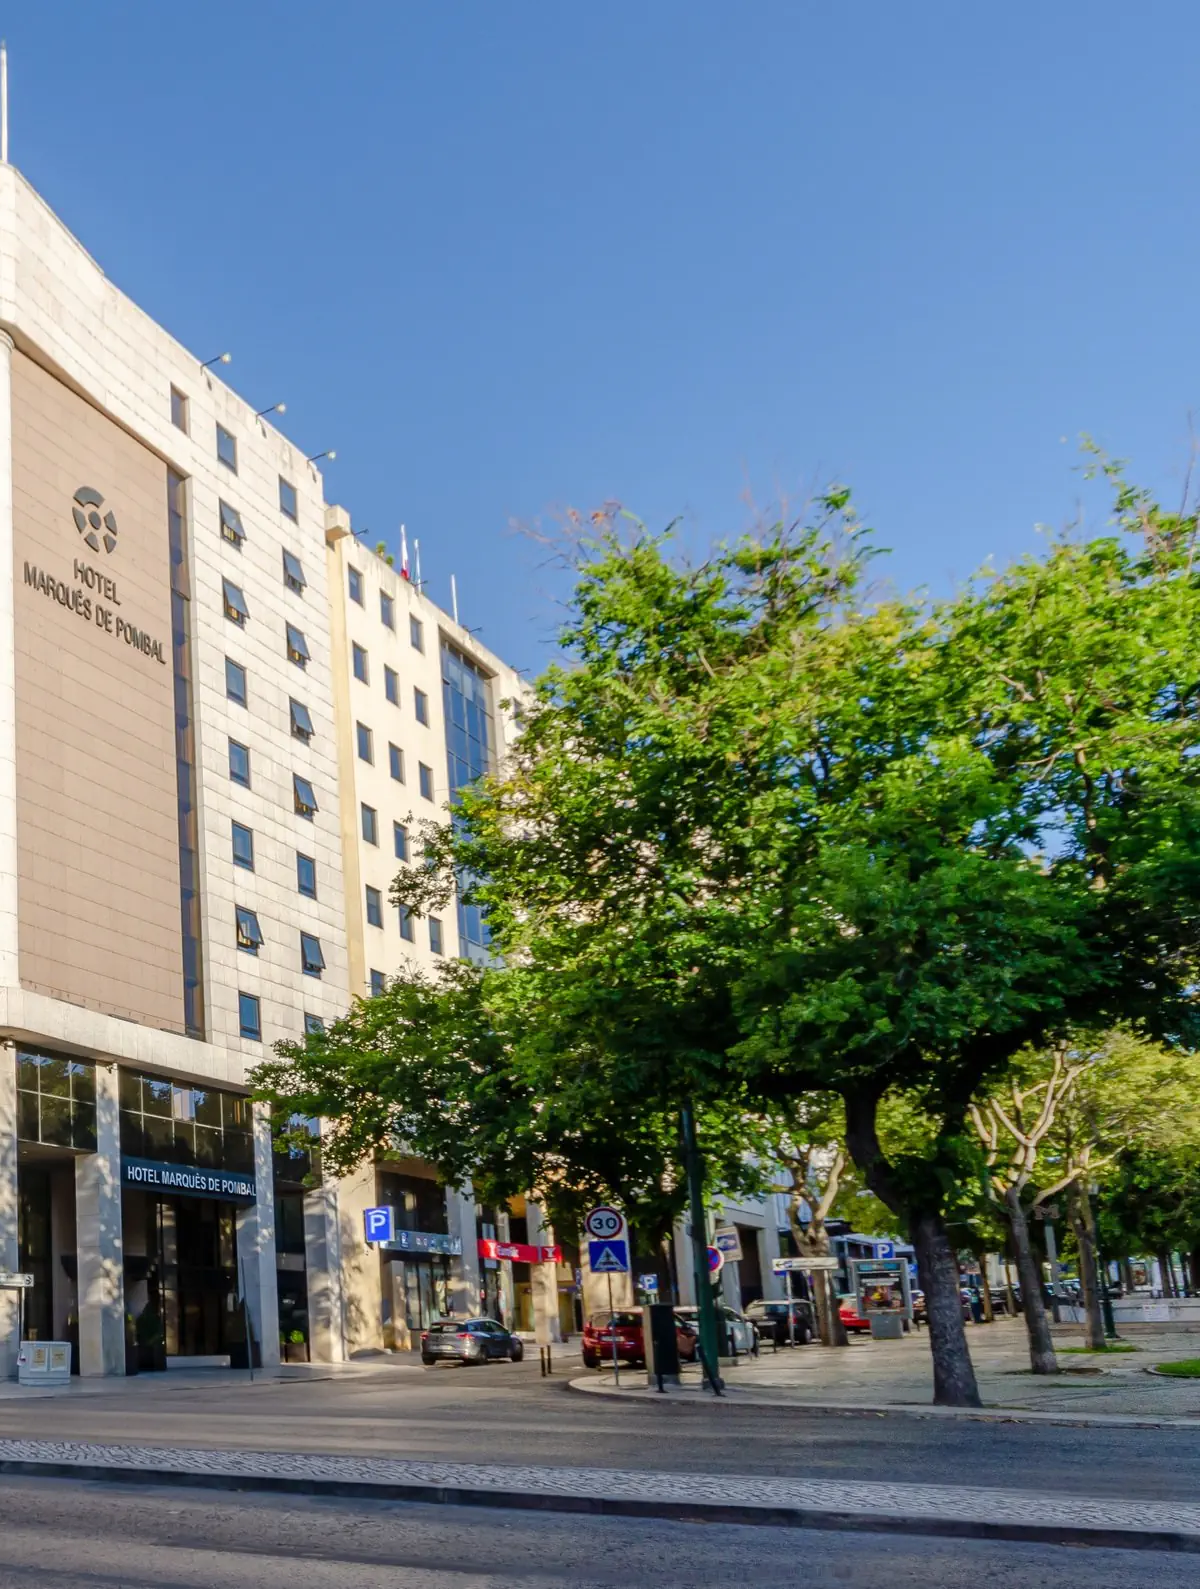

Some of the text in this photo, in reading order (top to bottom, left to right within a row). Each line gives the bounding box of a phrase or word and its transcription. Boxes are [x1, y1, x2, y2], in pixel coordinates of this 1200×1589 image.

[74, 558, 121, 606] HOTEL
[96, 604, 113, 633] DE
[116, 616, 167, 665] POMBAL
[127, 1166, 160, 1183] HOTEL
[208, 1177, 221, 1192] DE
[222, 1179, 257, 1197] POMBAL
[370, 1214, 386, 1234] P
[592, 1217, 617, 1229] 30
[877, 1244, 890, 1259] P
